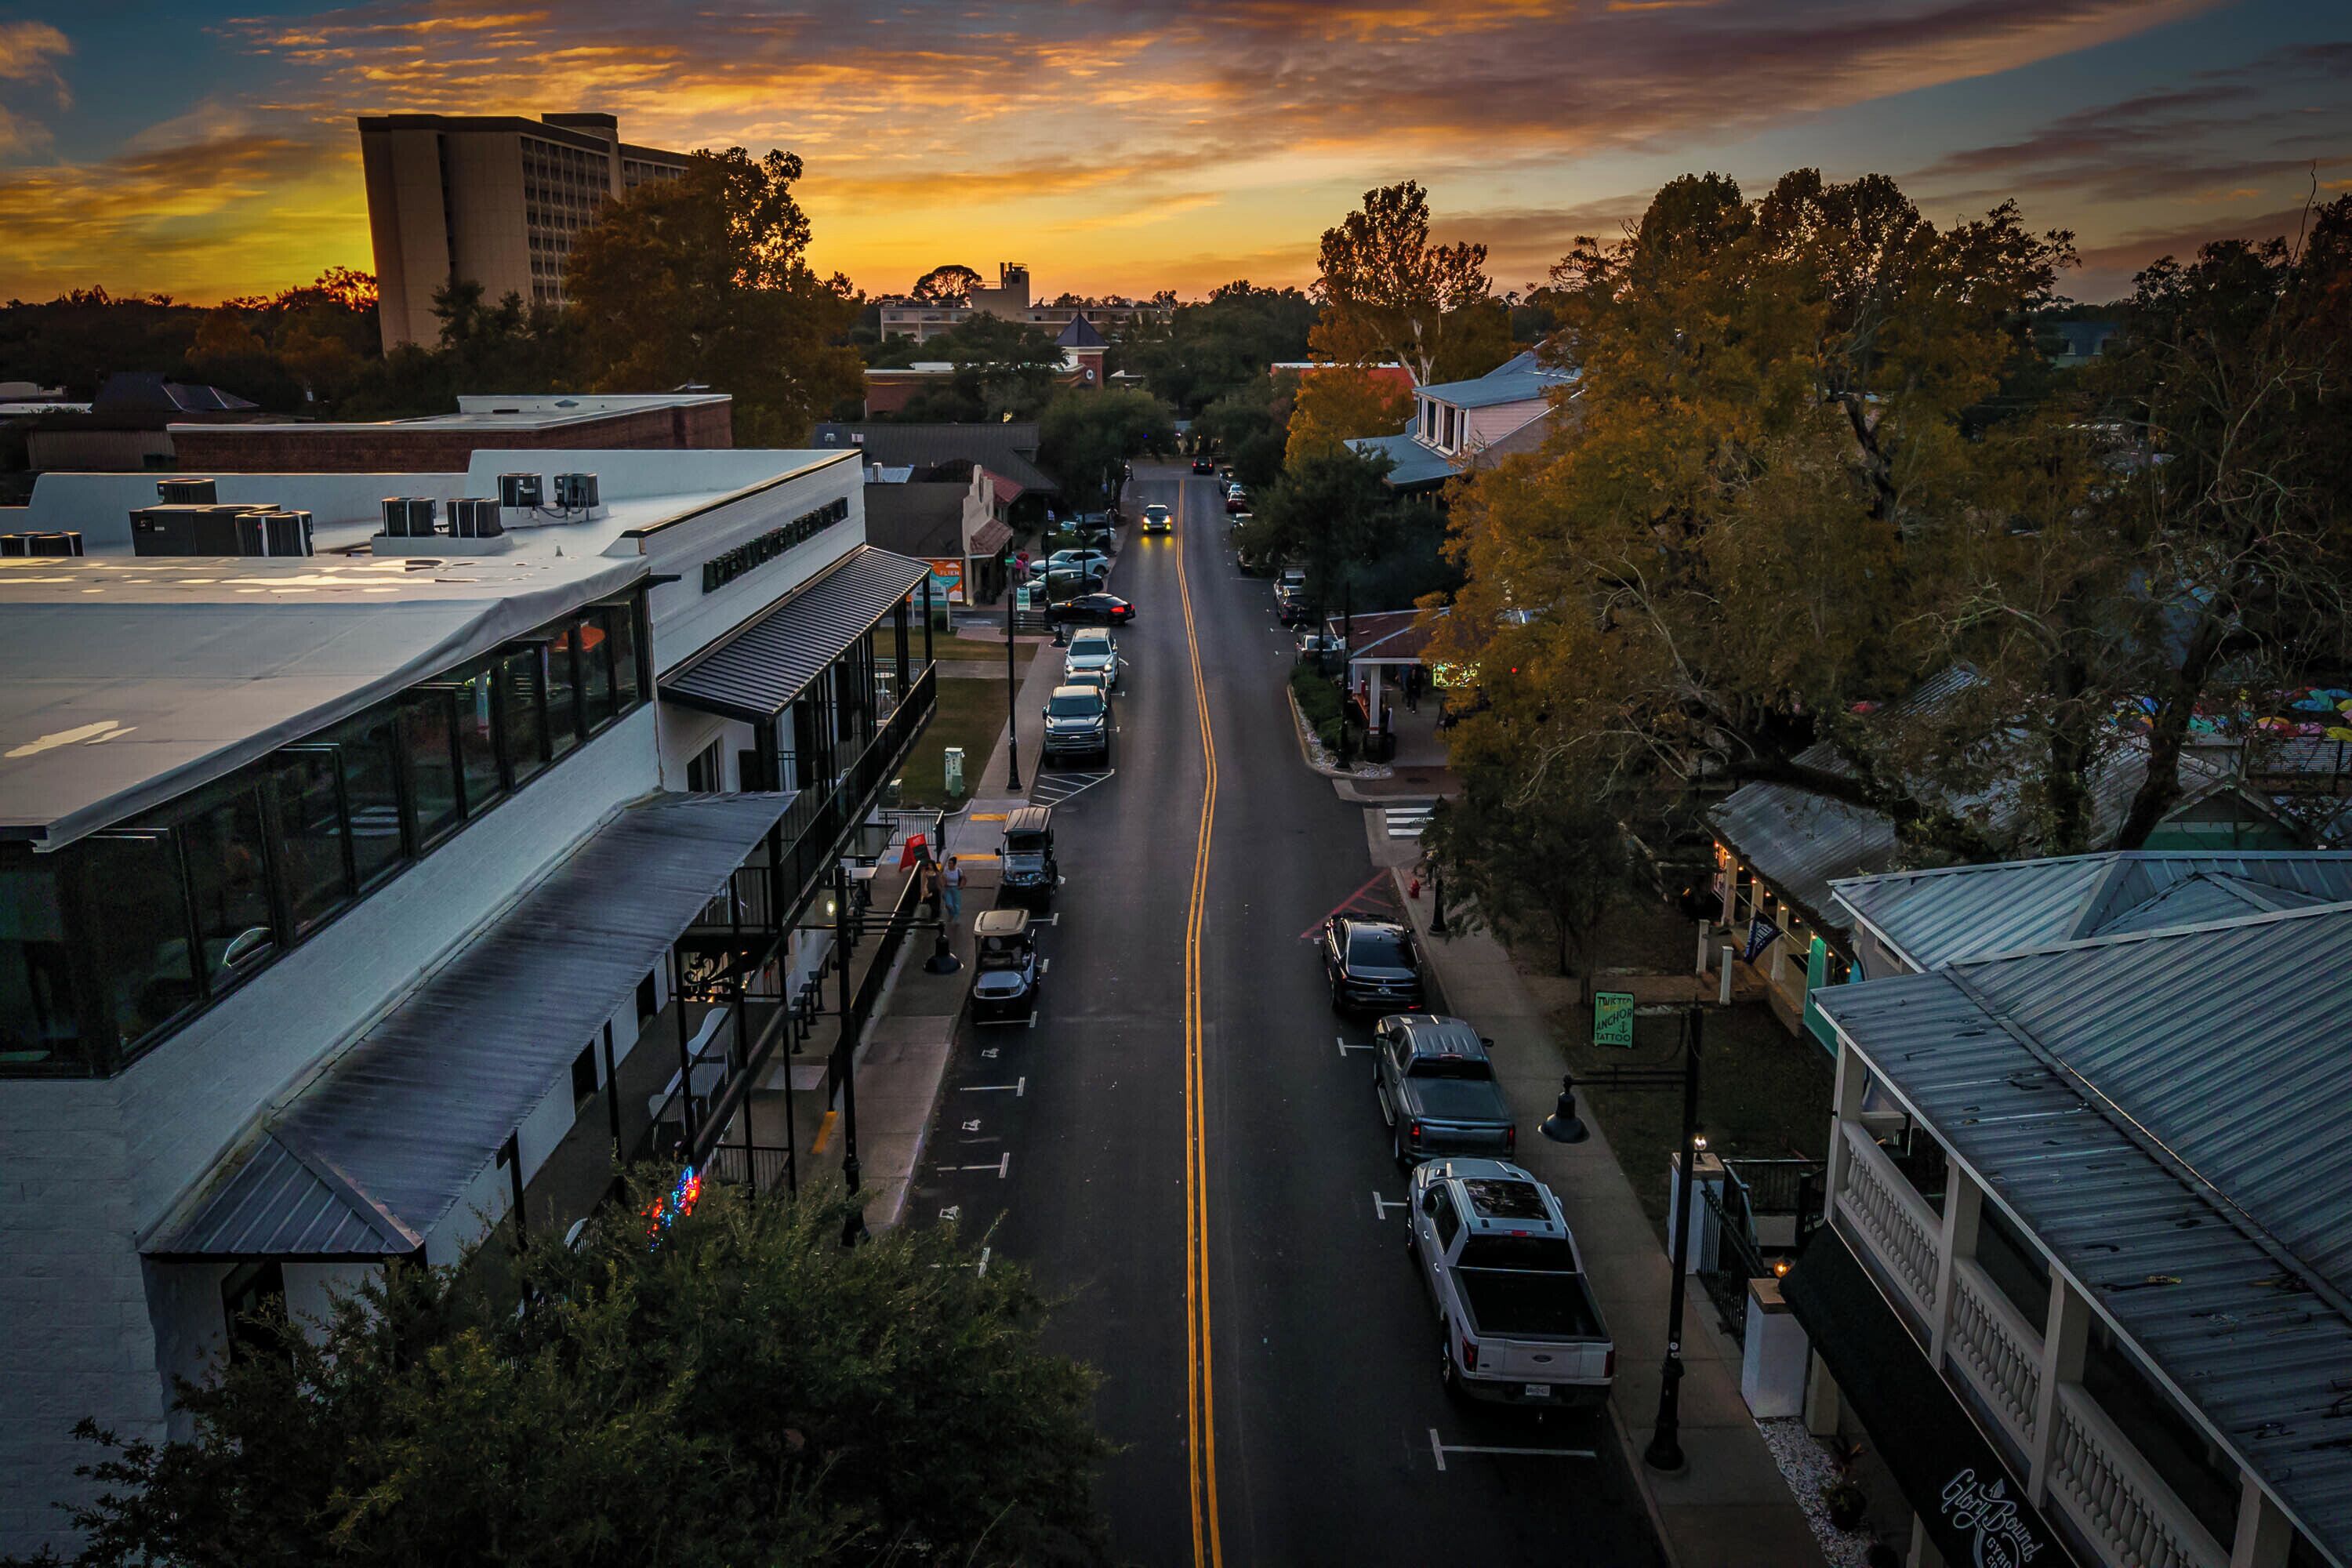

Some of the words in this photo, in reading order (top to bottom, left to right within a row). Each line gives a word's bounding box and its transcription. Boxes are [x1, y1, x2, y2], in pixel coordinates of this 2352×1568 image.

[1596, 1008, 1632, 1030] ANCHOR
[1595, 1033, 1631, 1042] TATTOO
[1940, 1468, 1993, 1529] Glory
[1979, 1483, 2045, 1563] Bound
